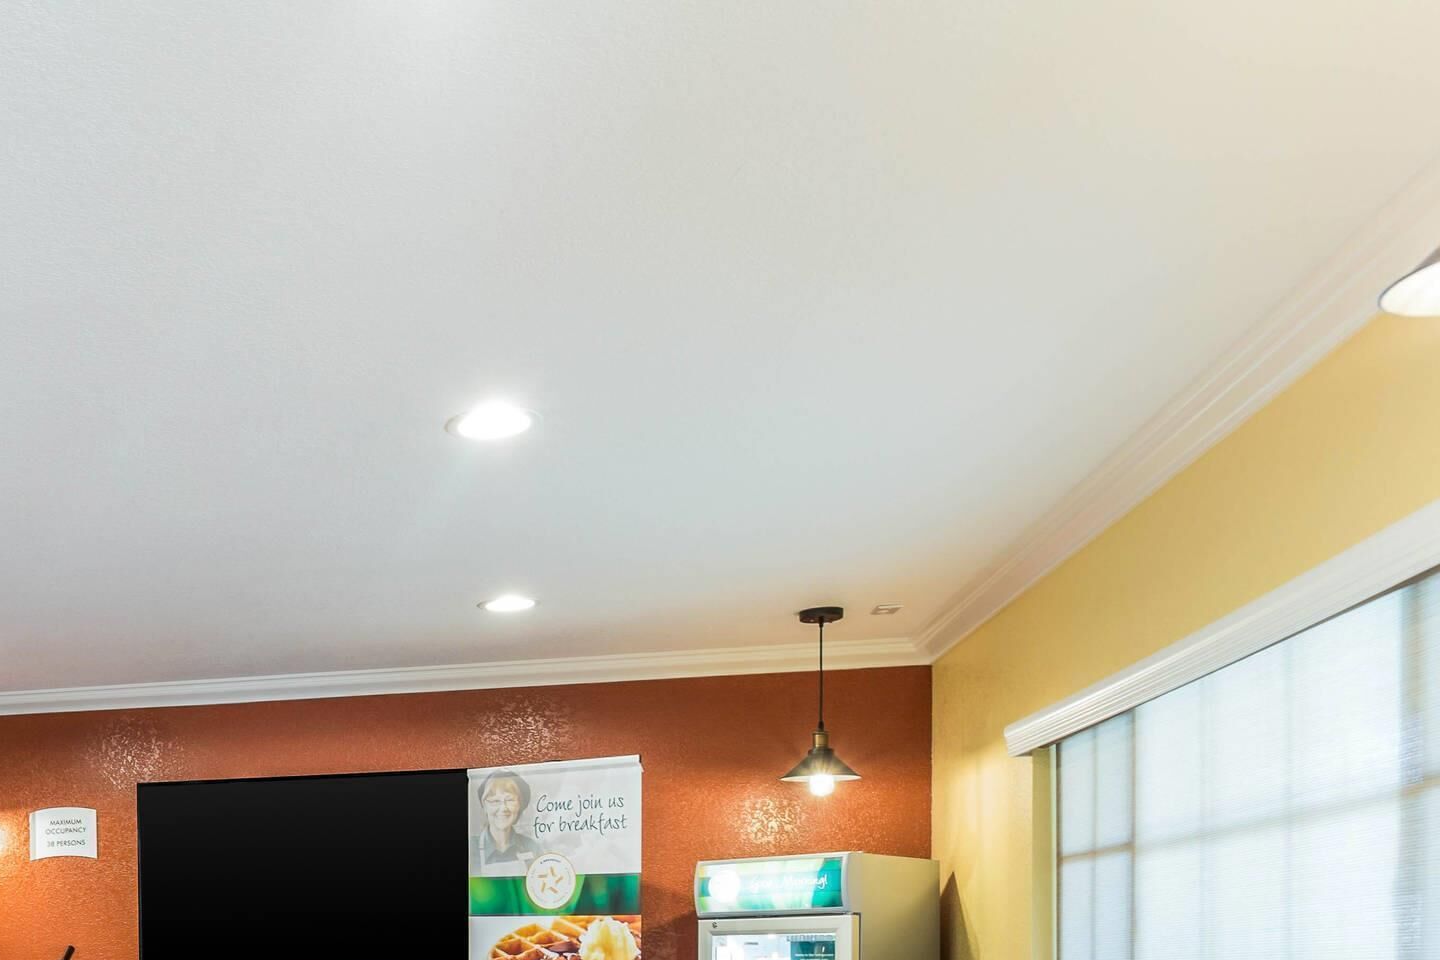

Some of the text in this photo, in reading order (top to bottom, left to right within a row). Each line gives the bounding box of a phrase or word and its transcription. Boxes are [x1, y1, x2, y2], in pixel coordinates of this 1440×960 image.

[536, 793, 625, 817] Come join us
[49, 818, 82, 826] MAXIMUM
[533, 813, 628, 839] for breakfast
[44, 826, 87, 836] OCCUPANCY
[56, 839, 87, 847] PERSONS
